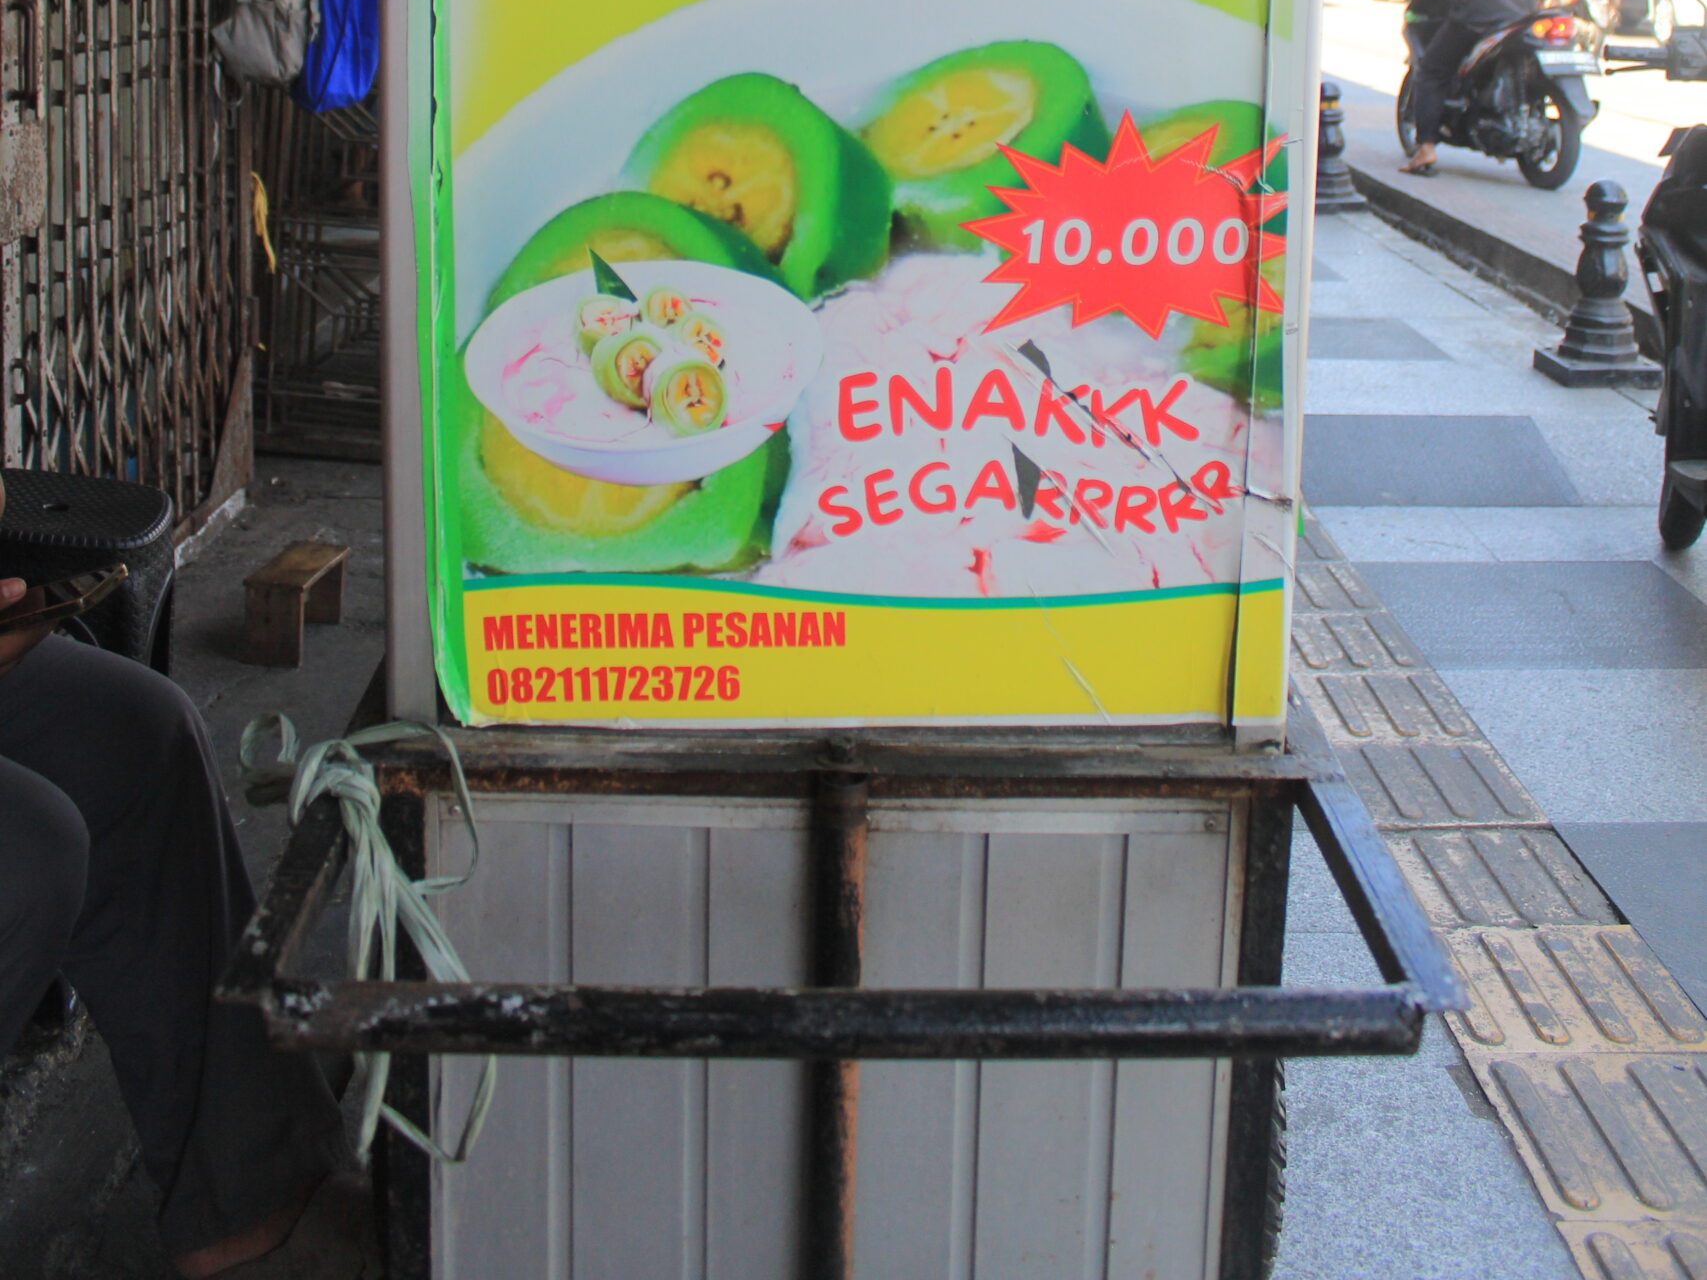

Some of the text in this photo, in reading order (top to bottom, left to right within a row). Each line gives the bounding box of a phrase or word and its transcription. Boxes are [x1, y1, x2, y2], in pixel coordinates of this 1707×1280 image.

[1020, 217, 1249, 266] 10.000
[837, 365, 1200, 449] ENAKKK
[482, 611, 846, 651] MENERIMA PESANAN
[486, 665, 741, 706] 082111723726
